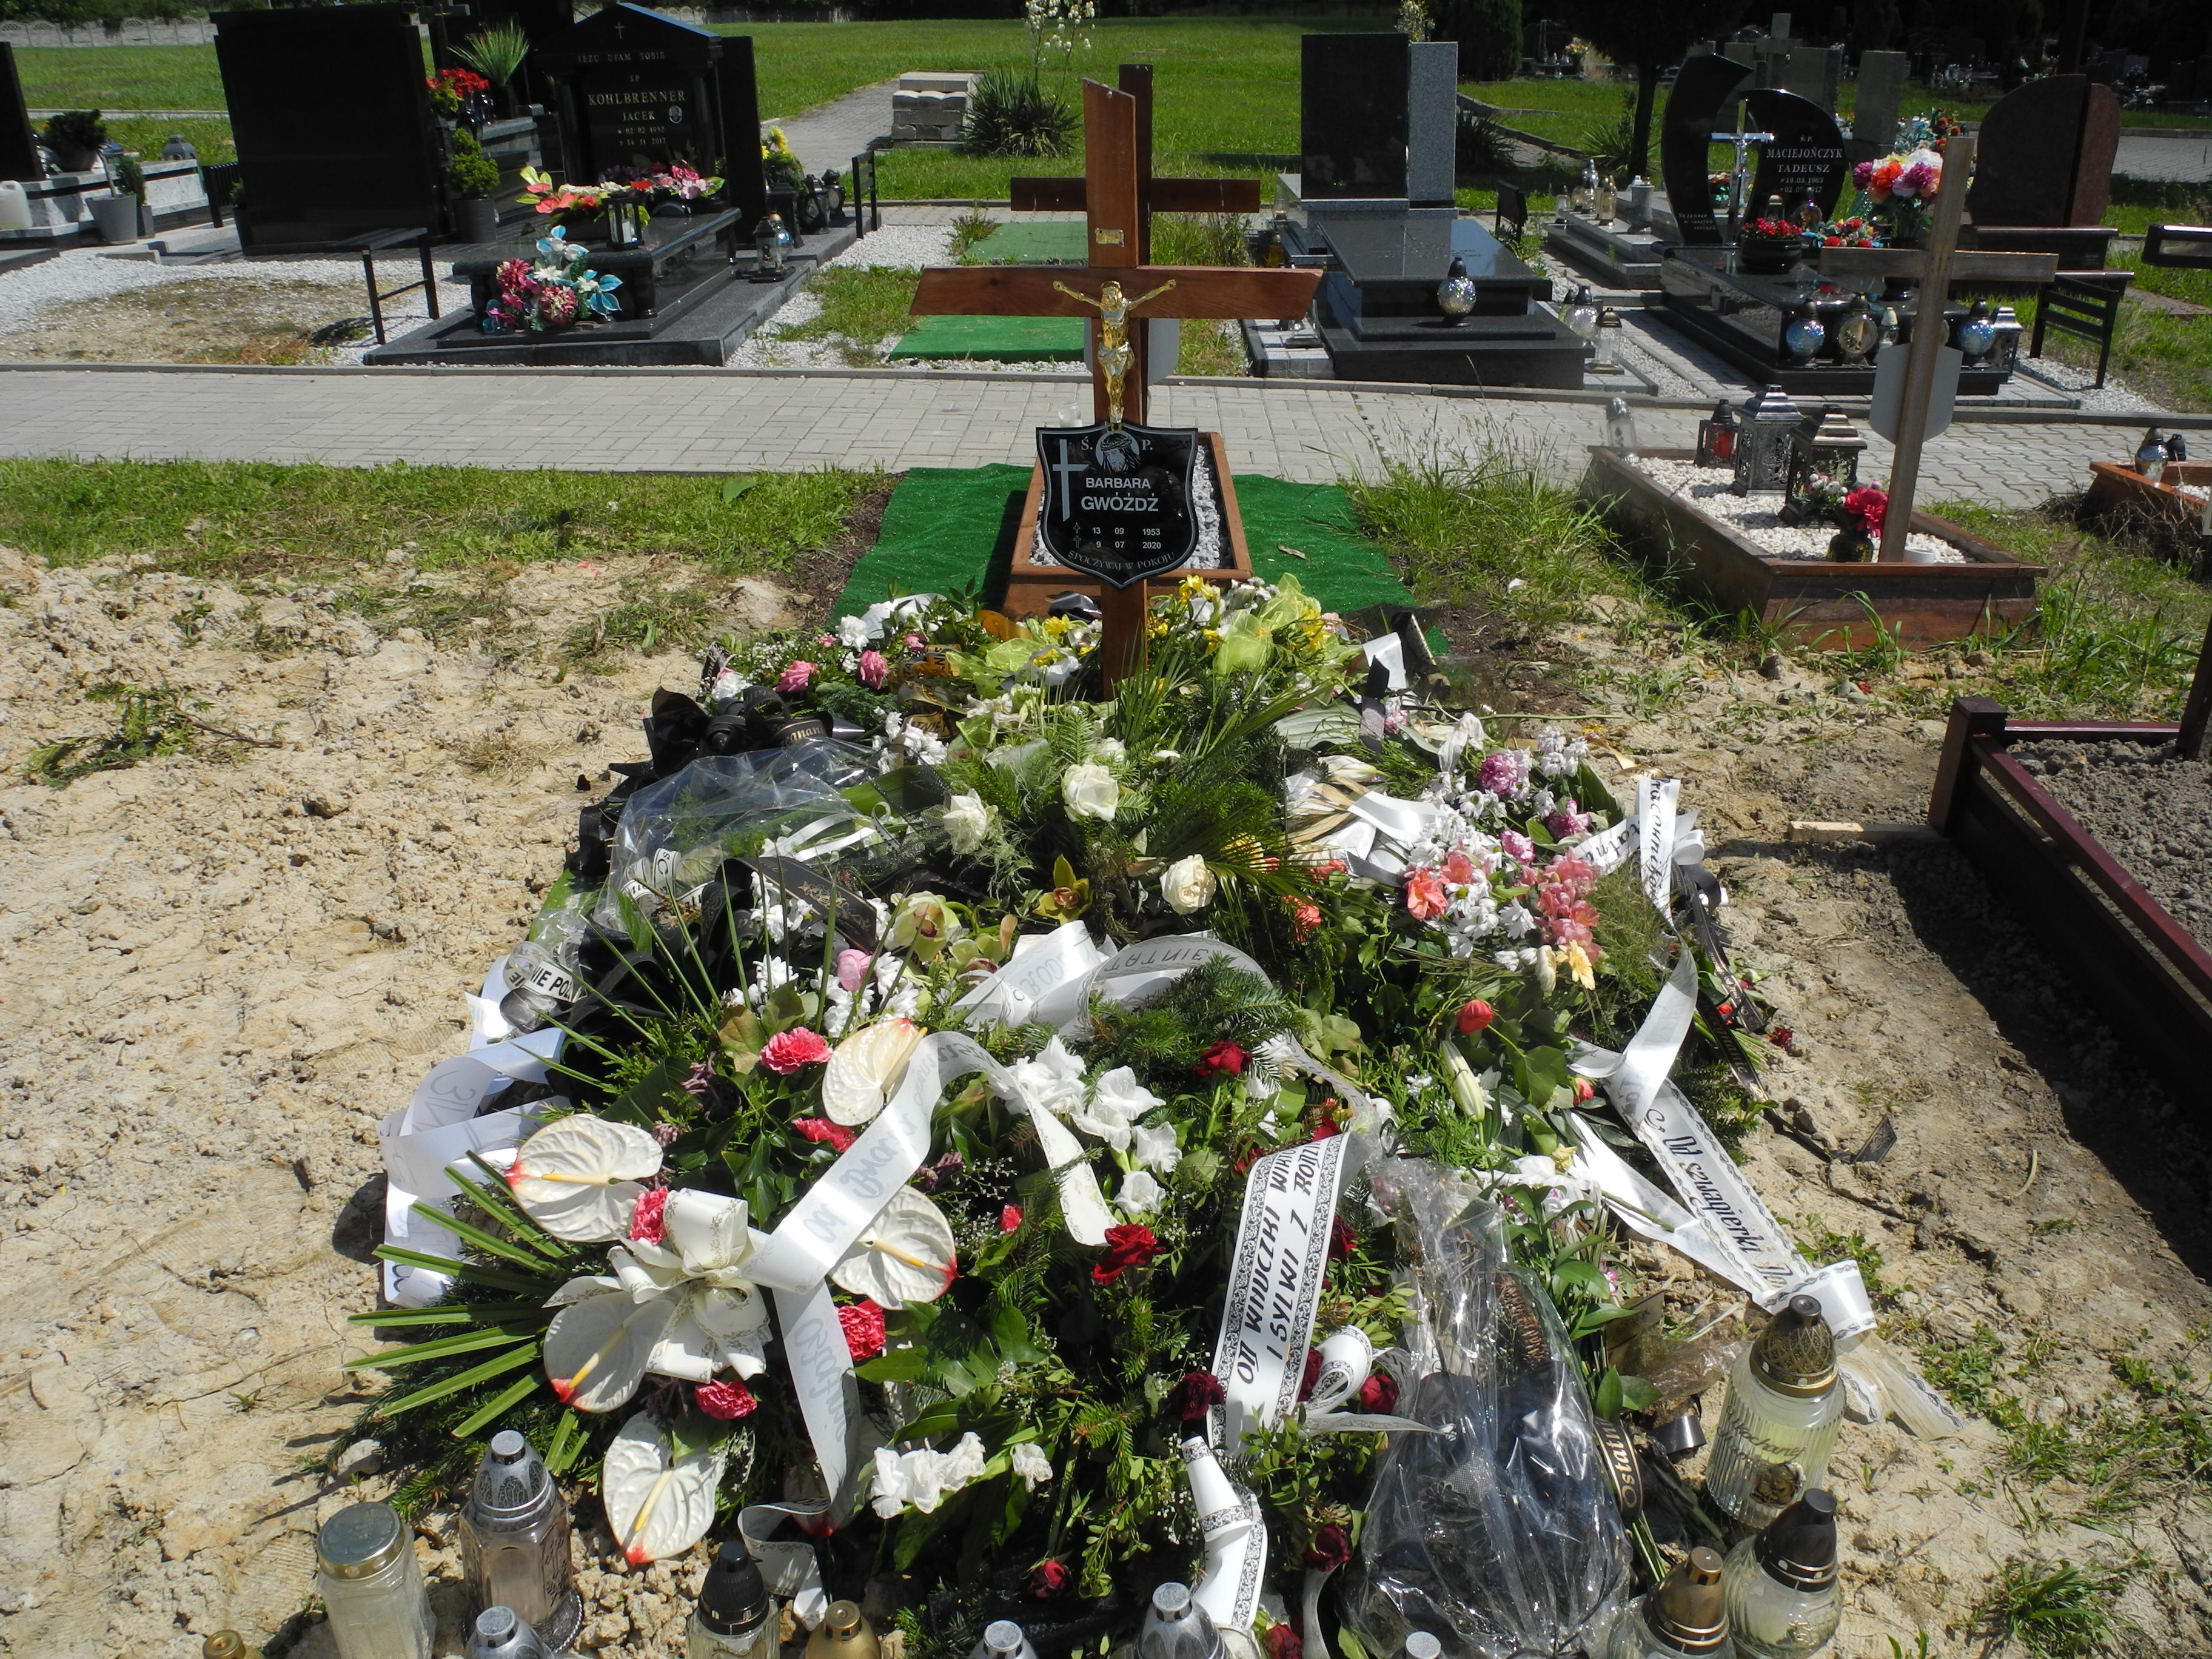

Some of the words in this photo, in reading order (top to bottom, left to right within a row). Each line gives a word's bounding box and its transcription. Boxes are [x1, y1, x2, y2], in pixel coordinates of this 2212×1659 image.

[607, 53, 631, 62] UFAM
[588, 90, 686, 106] KOHLBRENNER
[622, 110, 656, 121] JACEK
[1766, 146, 1843, 158] MACIEJOŃCZYK
[1777, 164, 1831, 173] TADEUSZ
[1081, 435, 1093, 451] Ś.
[1142, 438, 1153, 451] P.
[1085, 477, 1151, 489] BARBARA
[1081, 492, 1159, 512] GWÓŹDŹ
[1067, 550, 1122, 571] SPOCZYWAJ
[1137, 551, 1176, 569] POKOJU
[1270, 1247, 1300, 1344] SYLWI
[1290, 1208, 1309, 1237] Z
